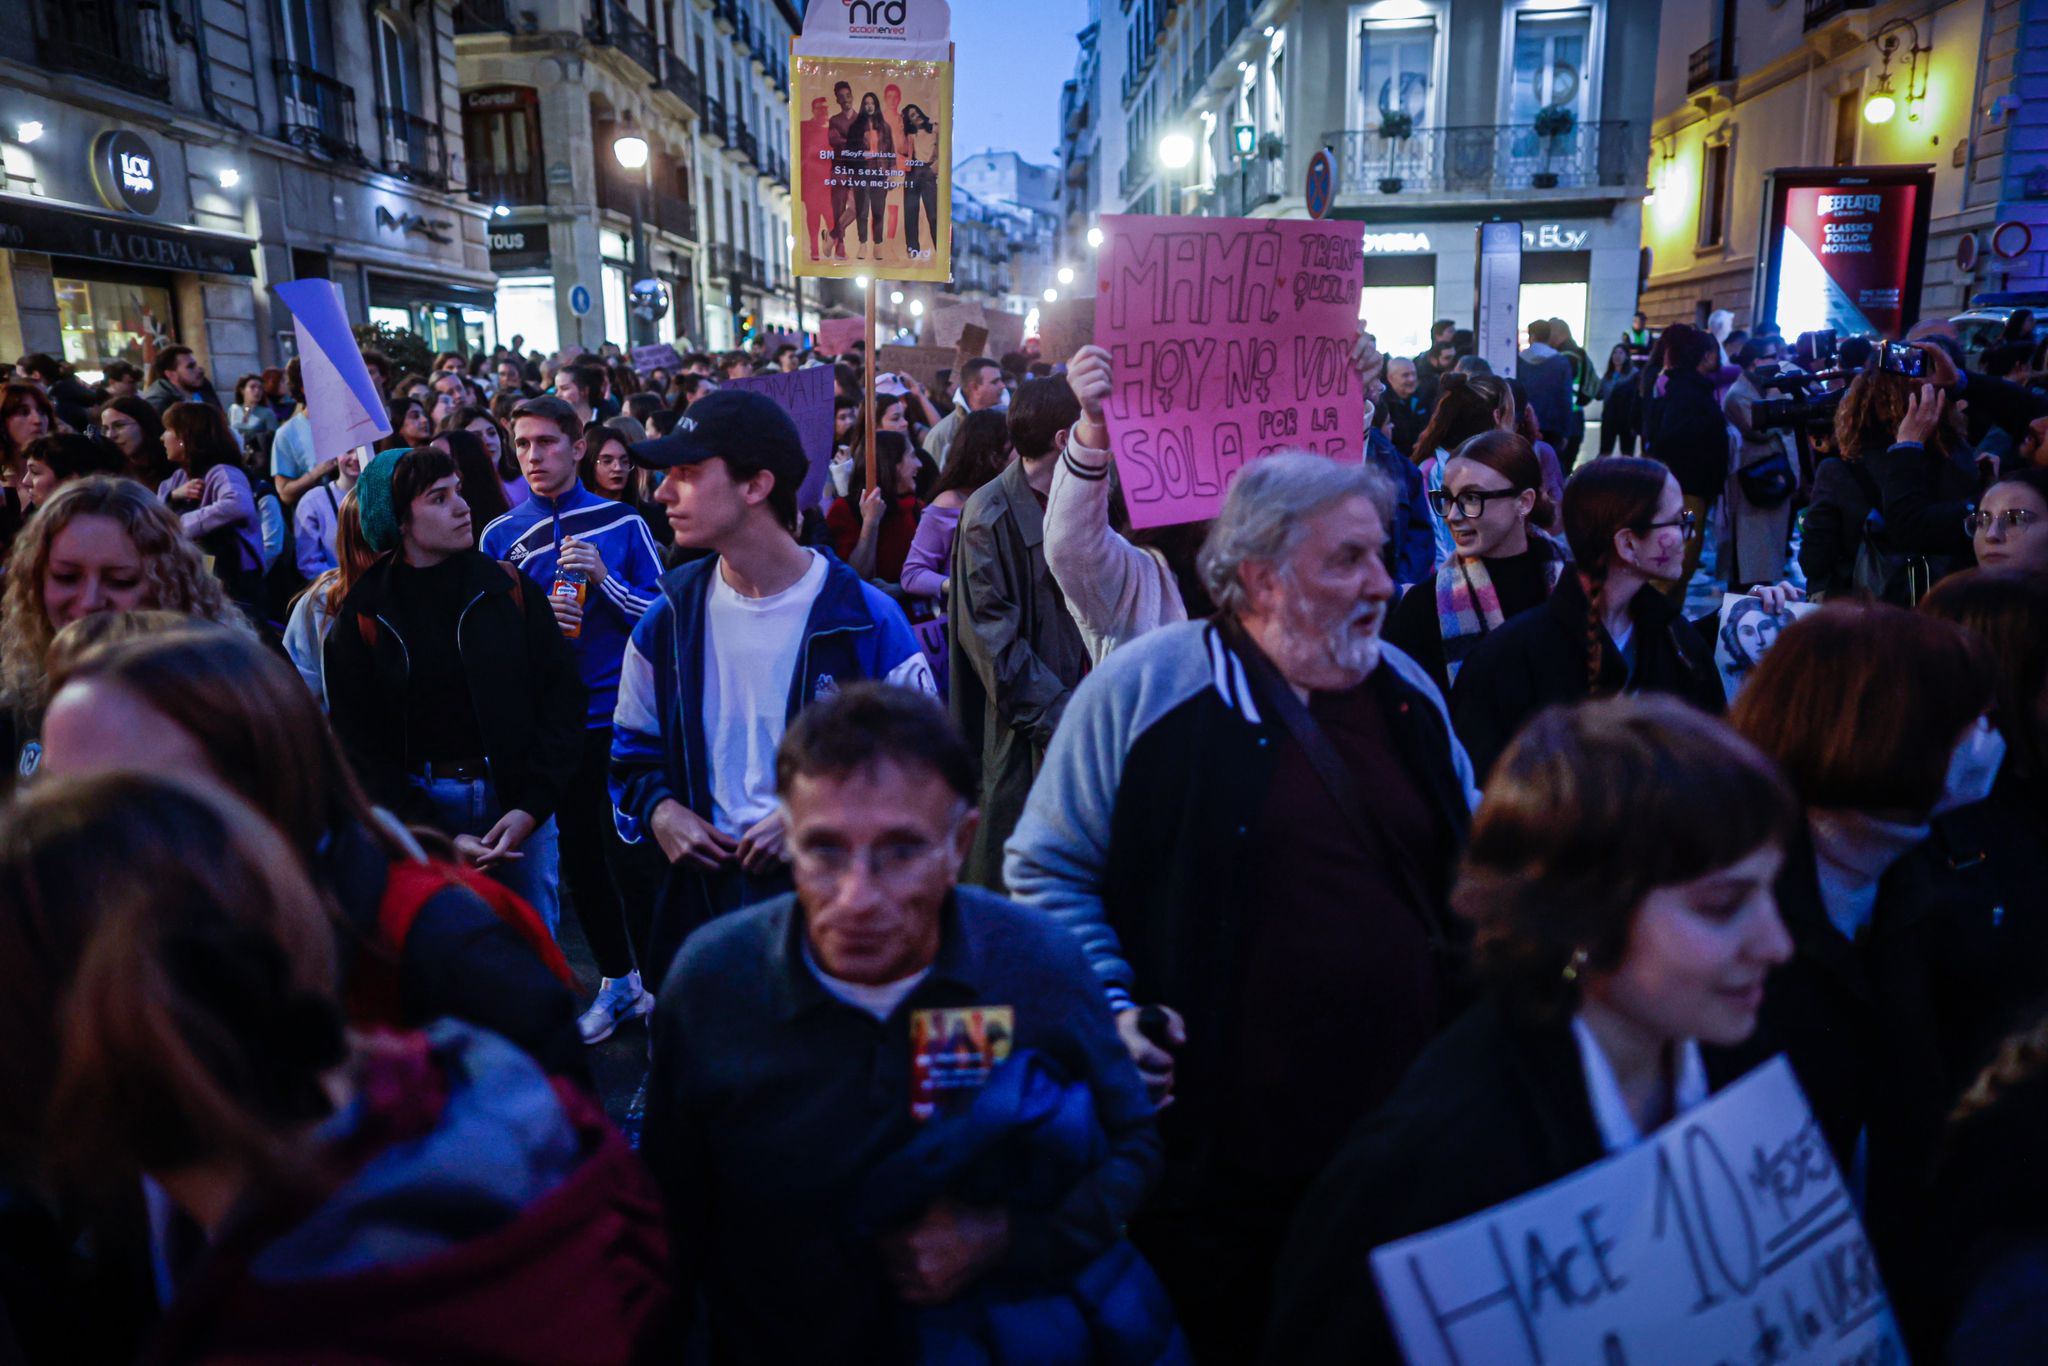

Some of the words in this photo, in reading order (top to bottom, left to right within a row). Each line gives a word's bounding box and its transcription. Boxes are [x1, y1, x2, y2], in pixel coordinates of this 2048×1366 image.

[820, 150, 834, 160] 8M
[841, 149, 897, 159] #SoyFeminista
[834, 166, 854, 175] Sin
[858, 168, 905, 177] sexismo
[824, 178, 837, 186] se
[841, 178, 867, 188] vive
[1817, 195, 1882, 216] BEEFEATER
[1823, 223, 1873, 233] CLASSICS
[1825, 233, 1870, 243] FOLLOW
[94, 229, 123, 257] LA
[128, 234, 193, 268] CUEVA
[1821, 243, 1872, 254] NOTHING
[1110, 337, 1217, 419] HOY
[1226, 338, 1277, 409] NO
[1294, 336, 1354, 401] VOY
[1258, 406, 1298, 440] POR
[1311, 406, 1339, 432] LA
[1120, 421, 1245, 503] SOLA
[1652, 1122, 1761, 1316] 10
